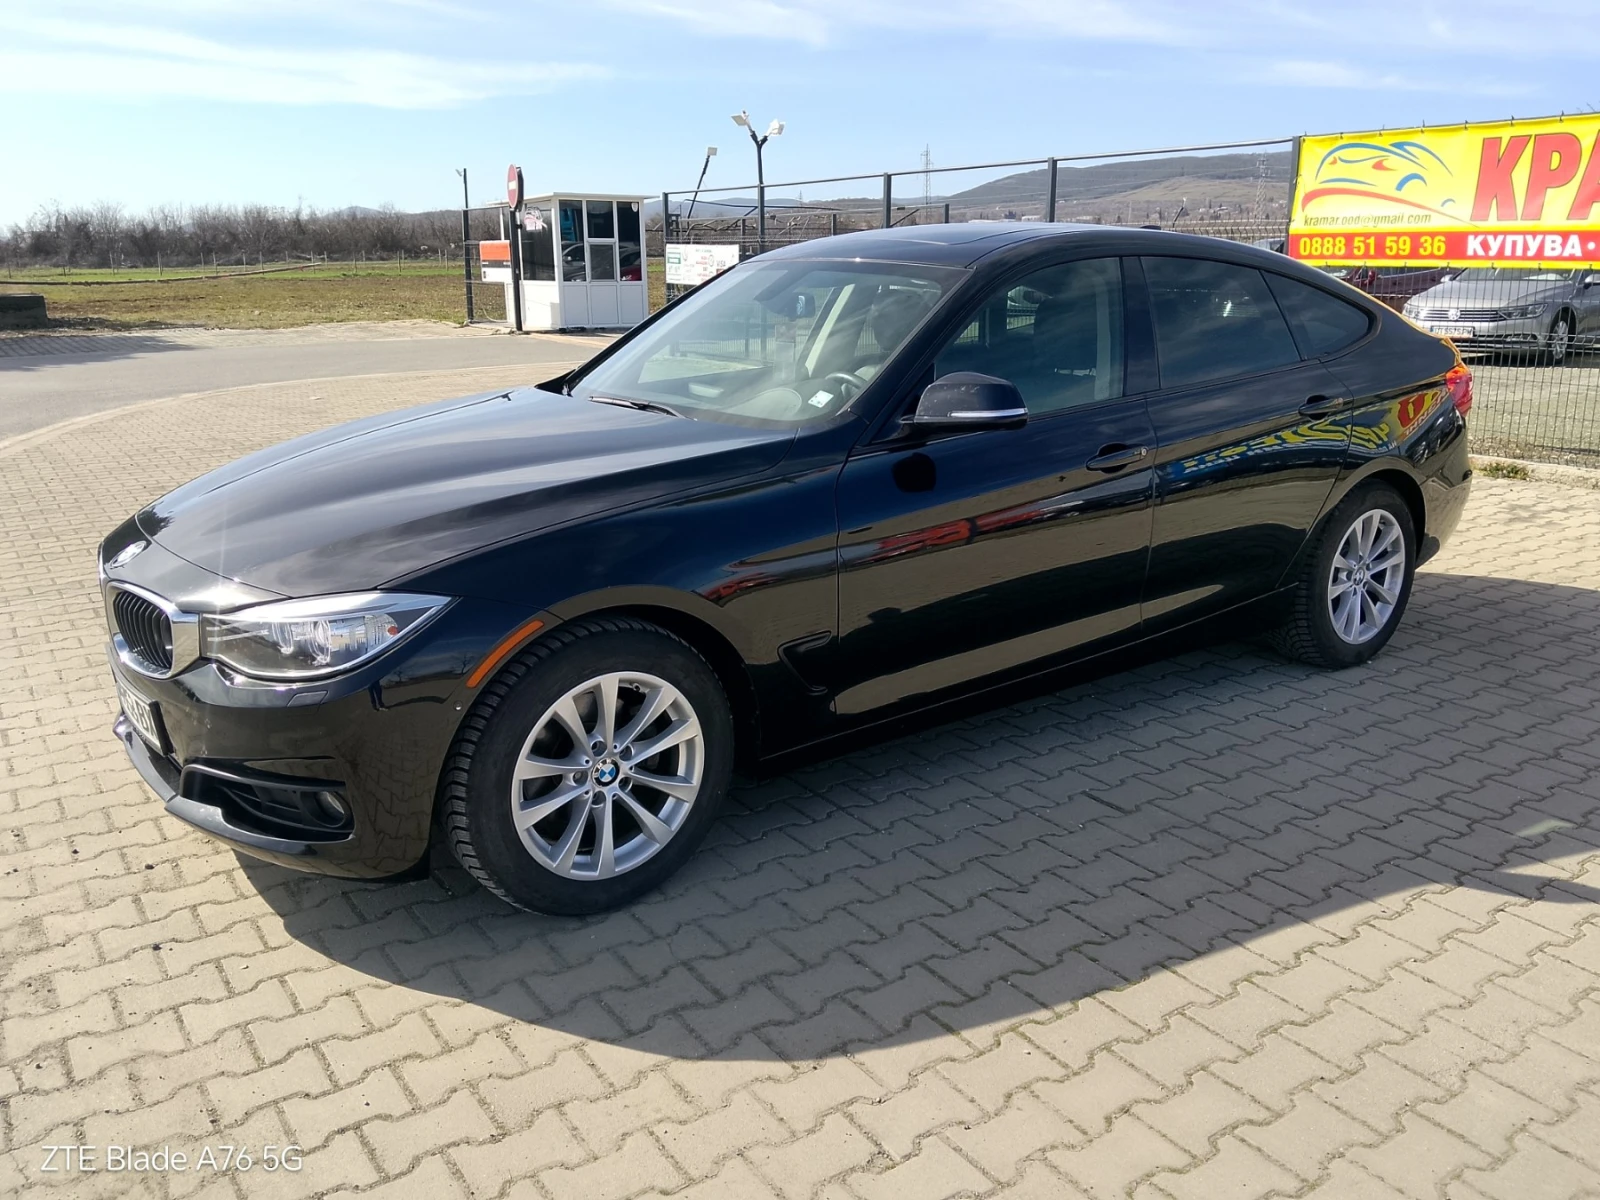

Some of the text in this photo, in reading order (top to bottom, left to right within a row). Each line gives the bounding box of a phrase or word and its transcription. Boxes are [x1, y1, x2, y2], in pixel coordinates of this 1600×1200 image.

[1303, 213, 1432, 228] kramar.ood@gmail.com
[1299, 235, 1446, 256] 0888 51 59 36
[1466, 234, 1583, 257] КУПУВА
